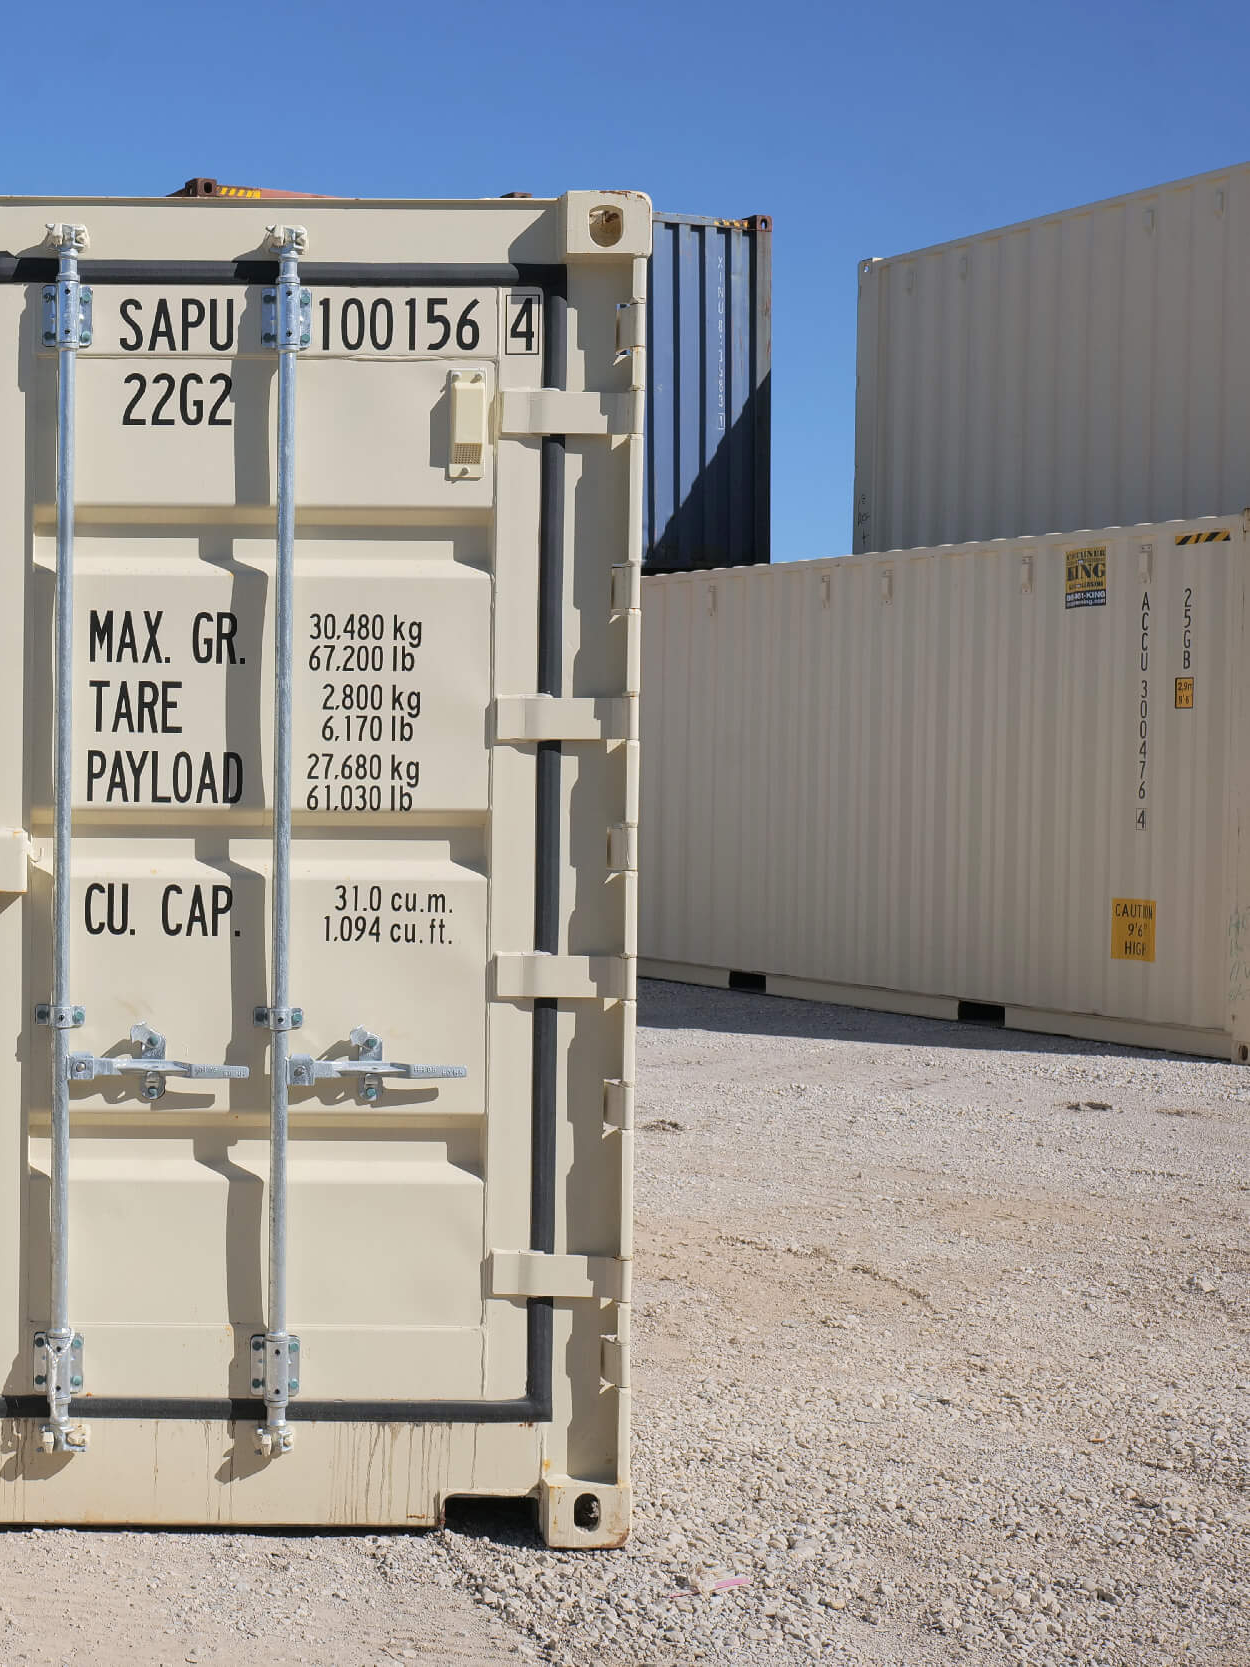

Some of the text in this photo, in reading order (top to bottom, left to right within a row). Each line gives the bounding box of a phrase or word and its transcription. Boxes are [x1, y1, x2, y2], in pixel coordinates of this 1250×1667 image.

[717, 256, 725, 314] XINU
[119, 297, 536, 352] SAPU 100156 4
[122, 372, 233, 427] 22G2
[88, 609, 247, 665] MAX. GR.
[393, 614, 423, 649] kg
[1141, 592, 1150, 671] ACCU
[1182, 588, 1192, 670] 25GB
[392, 645, 416, 672] lb
[89, 680, 183, 733] TARE
[391, 684, 422, 719] kg
[391, 715, 414, 742] lb
[1139, 680, 1148, 799] 300476
[86, 750, 244, 804] PAYLOAD
[390, 754, 420, 789] kg
[390, 785, 413, 812] lb
[84, 882, 241, 937] CU. CAP.
[334, 884, 454, 914] 31.0 cu.m.
[1115, 903, 1153, 920] CAUTION
